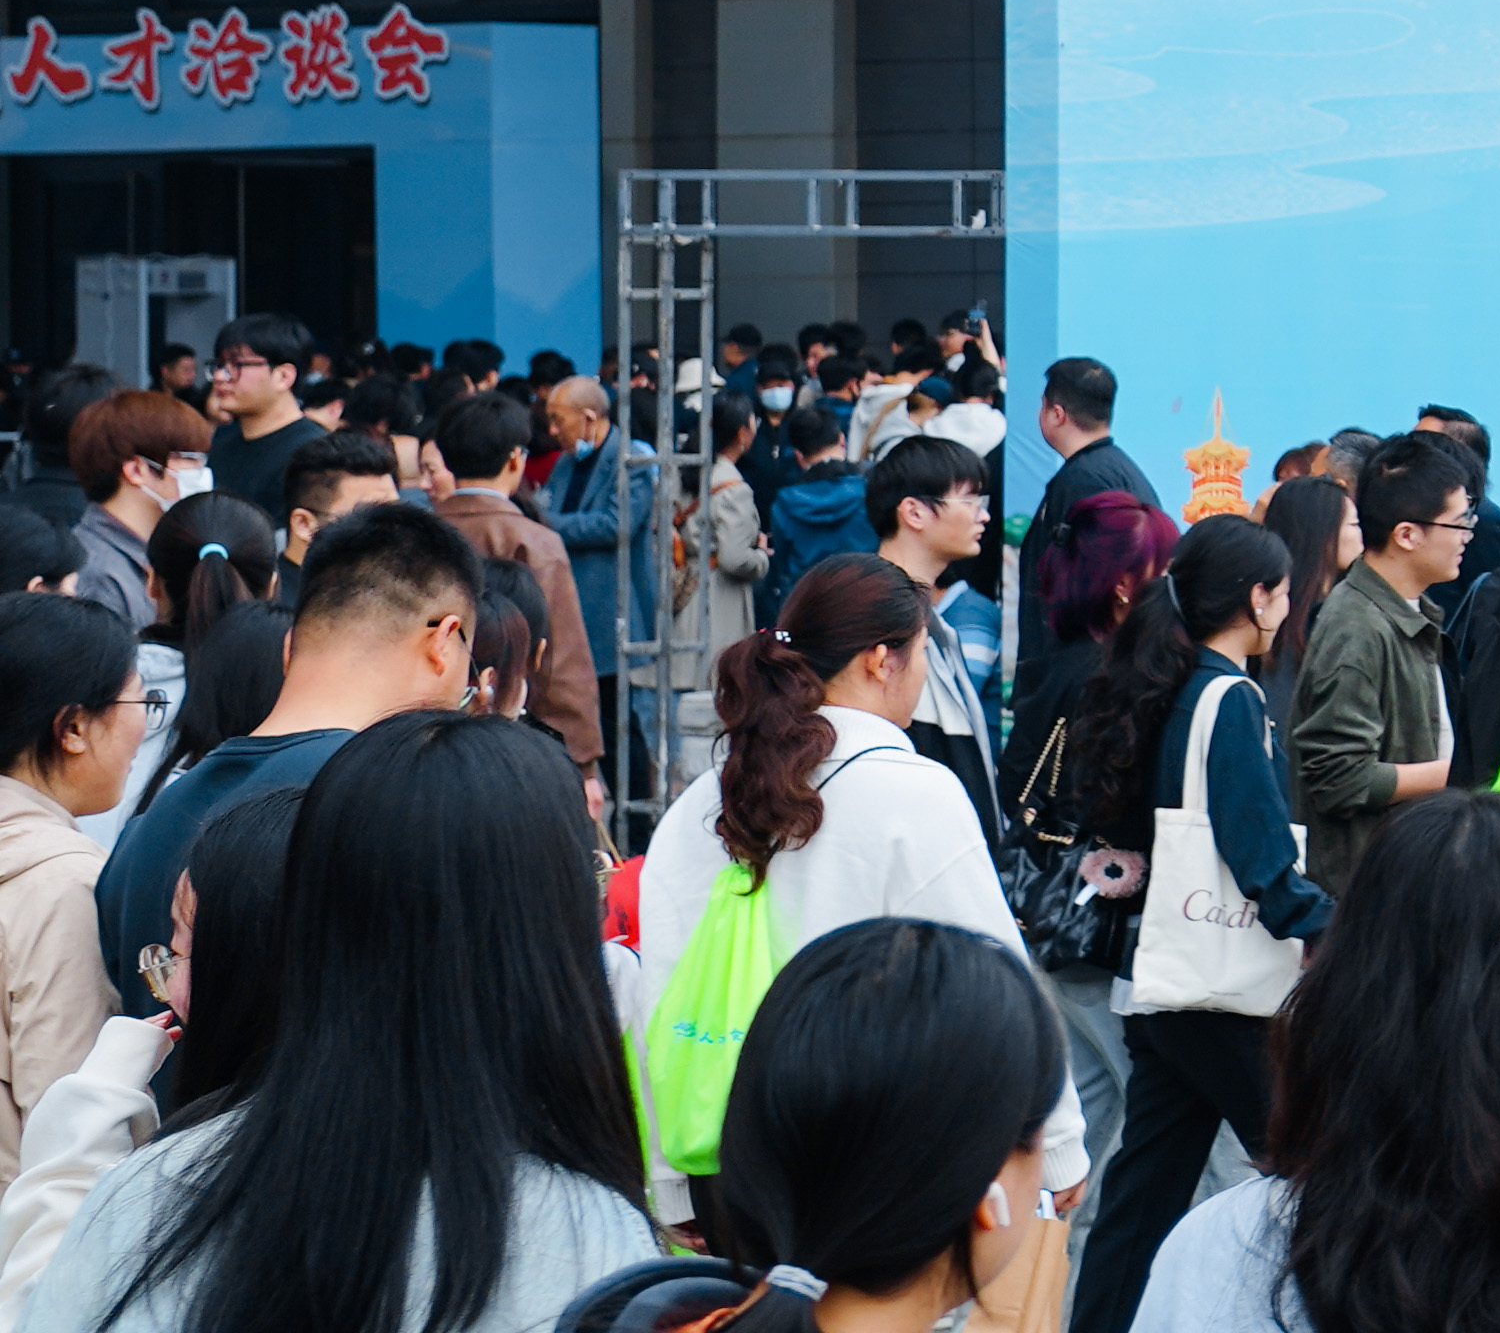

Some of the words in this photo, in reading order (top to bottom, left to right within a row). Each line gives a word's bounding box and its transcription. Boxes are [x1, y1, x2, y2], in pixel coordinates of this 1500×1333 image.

[3, 2, 450, 112] 人才洽谈会
